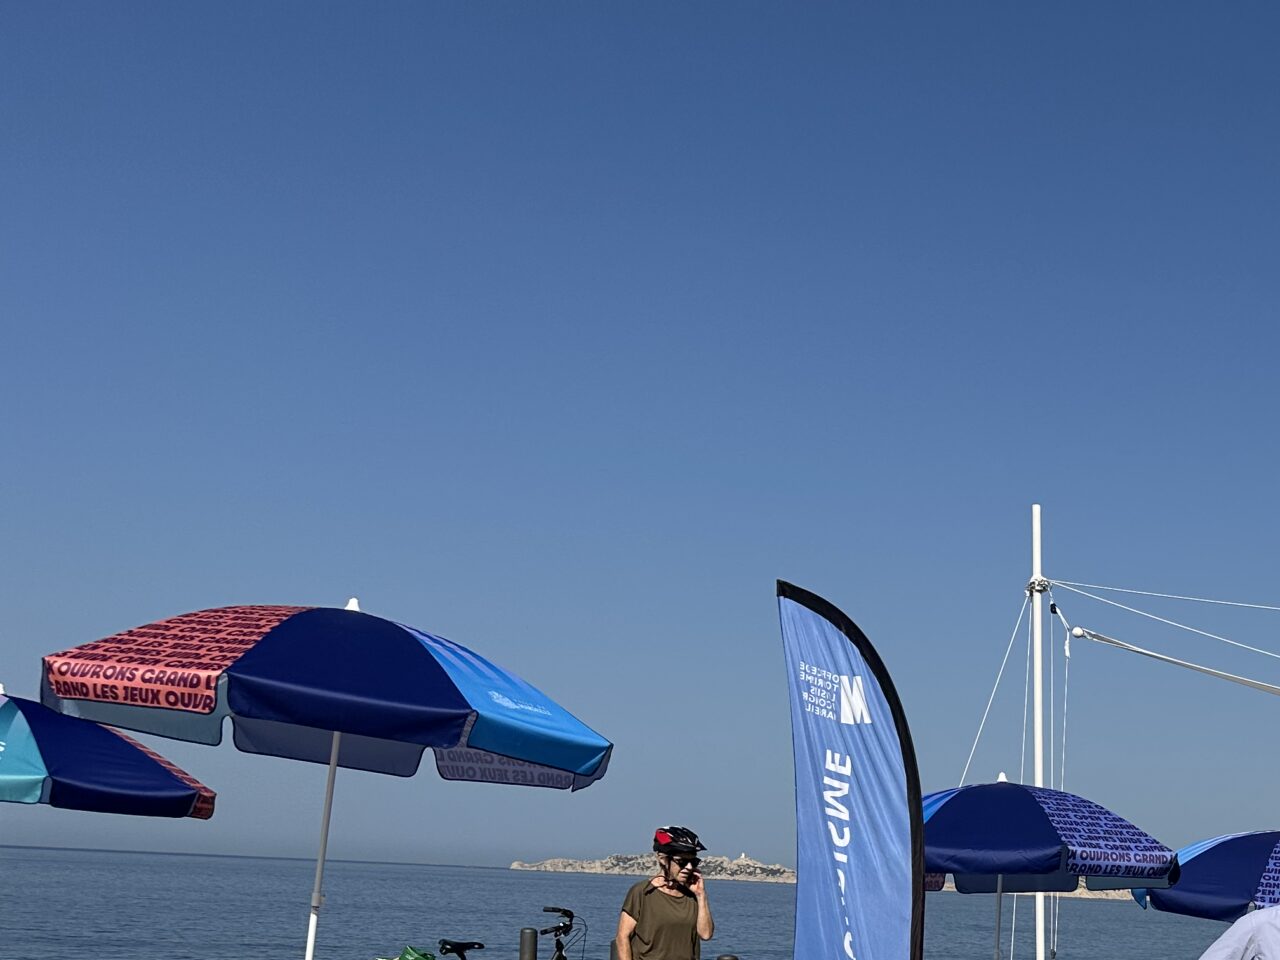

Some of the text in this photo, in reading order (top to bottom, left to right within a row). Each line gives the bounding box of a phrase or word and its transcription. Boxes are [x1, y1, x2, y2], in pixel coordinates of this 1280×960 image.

[58, 662, 139, 681] OUVRONS
[140, 669, 201, 689] GRAND
[92, 683, 119, 700] LES
[122, 686, 161, 705] JEUX
[1079, 850, 1132, 863] OUVRONS
[1133, 853, 1168, 865] GRAND
[1103, 864, 1124, 875] LES
[1121, 865, 1146, 876] JEUX
